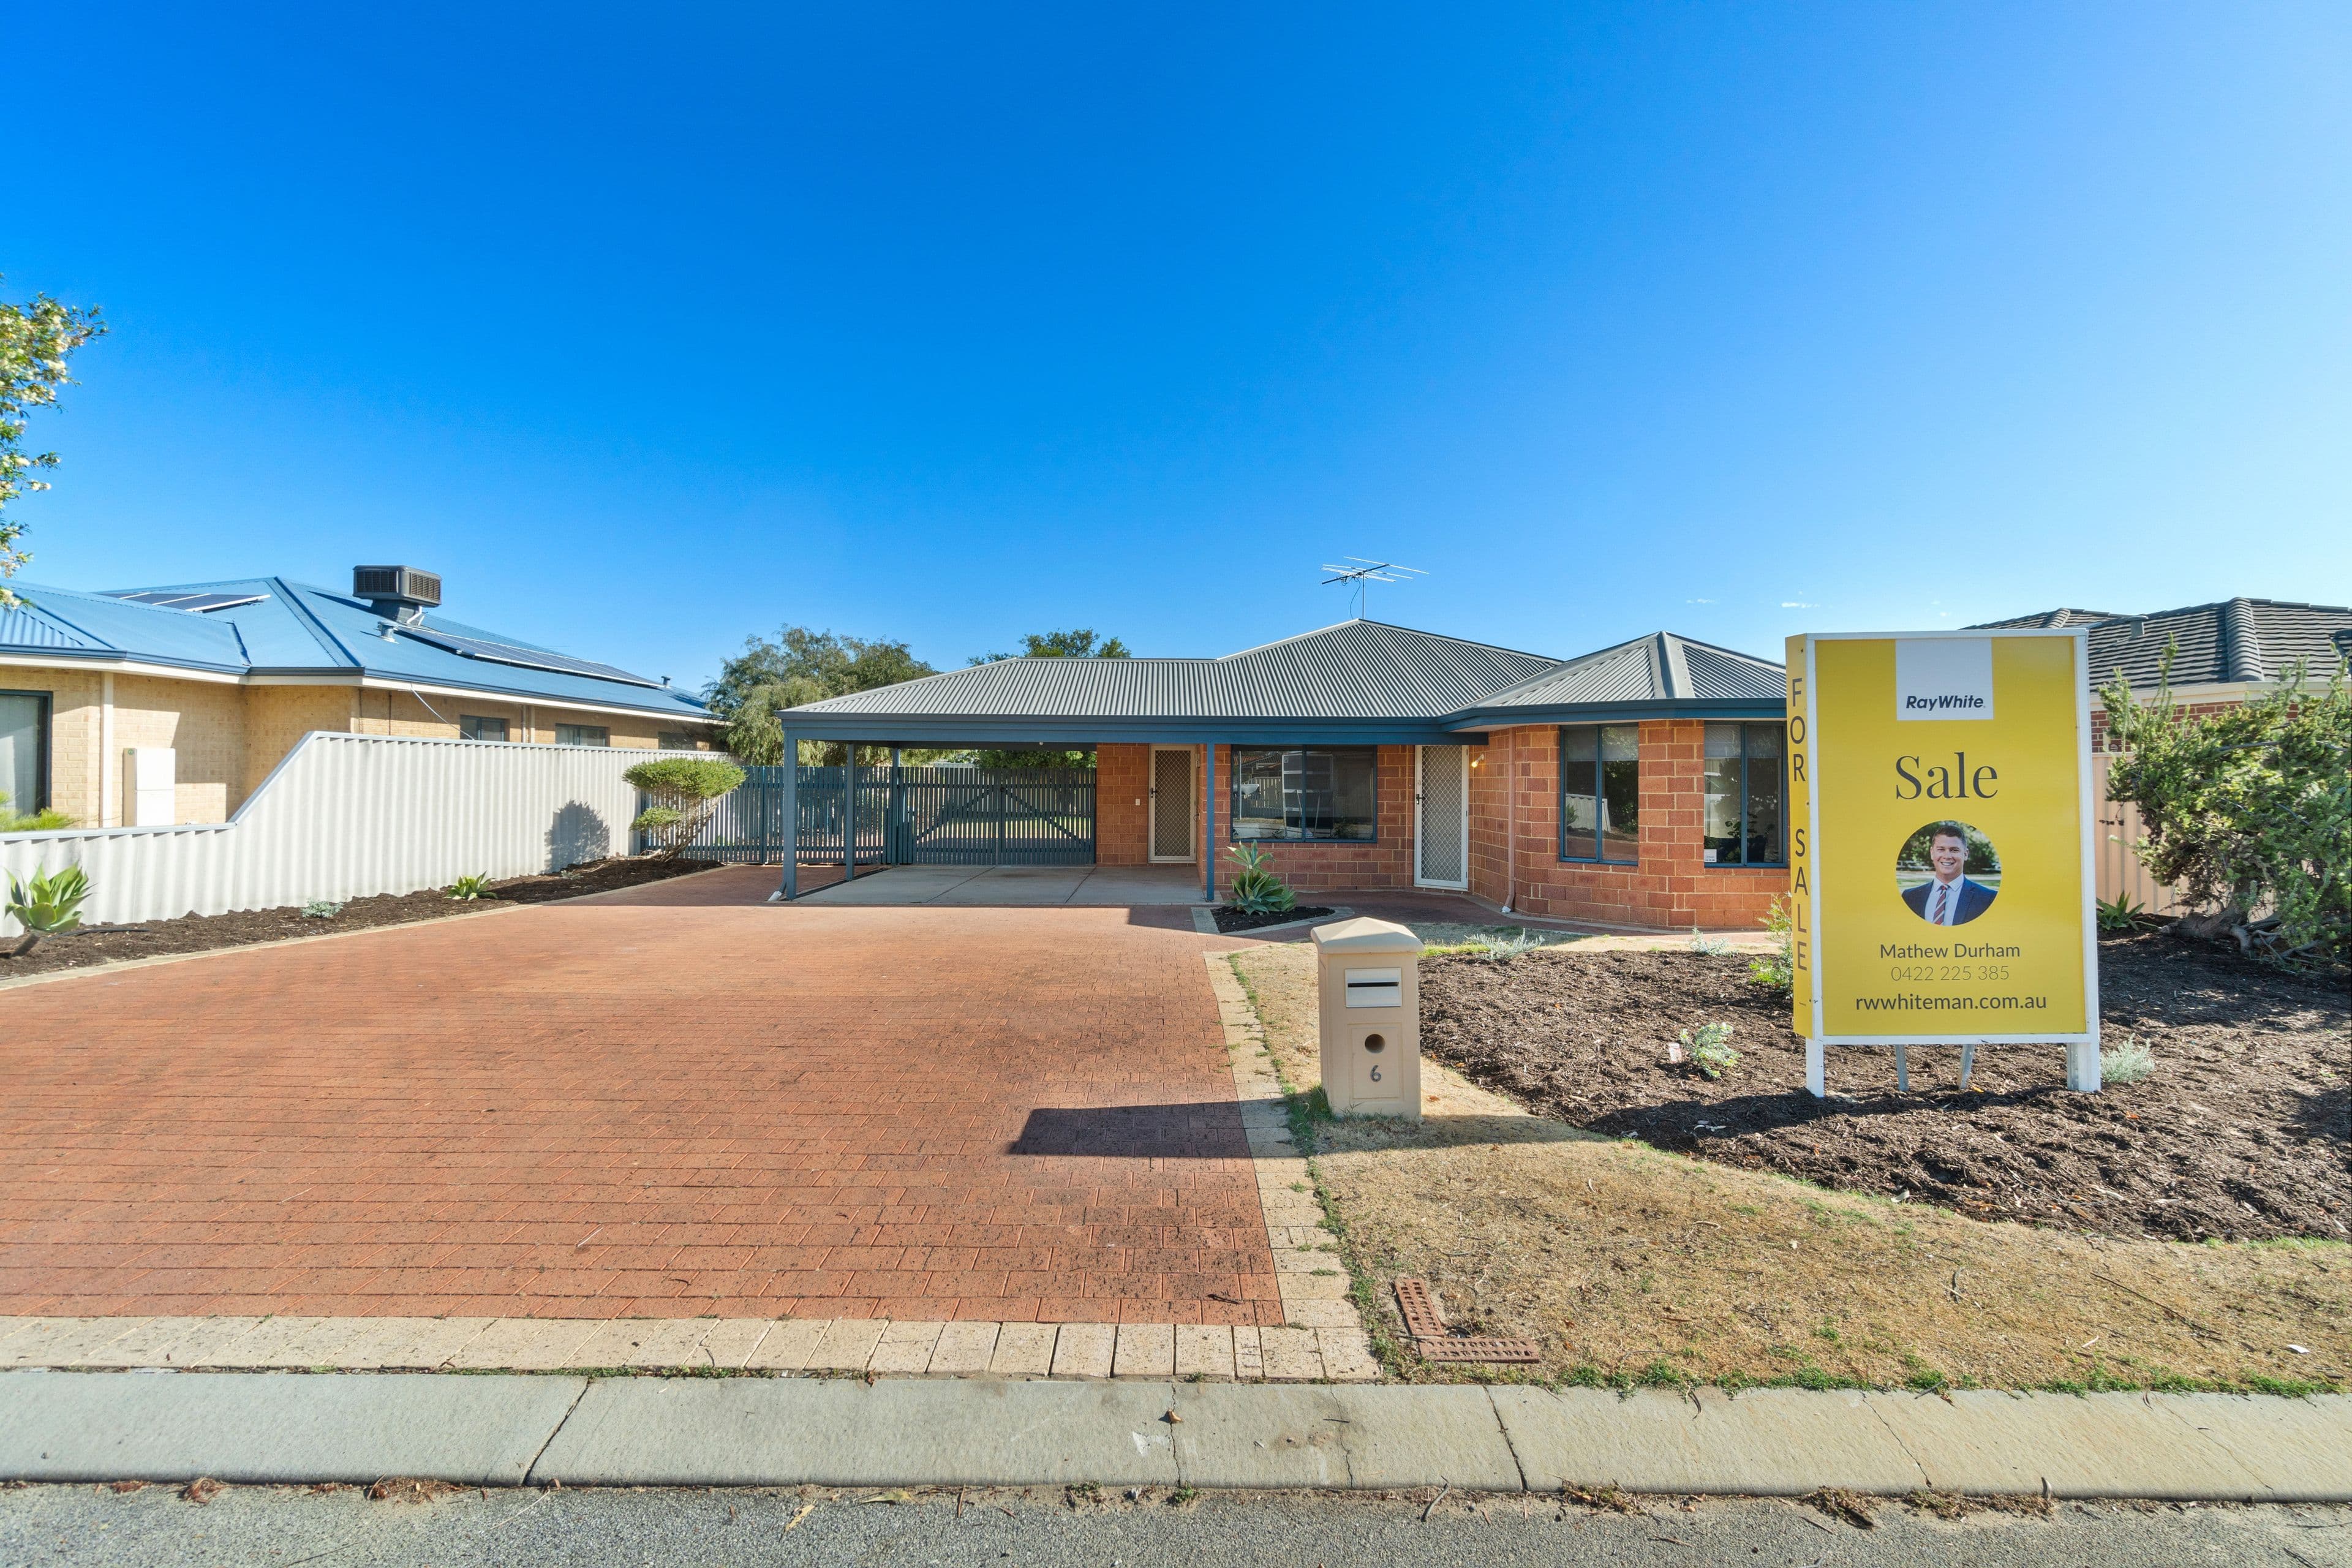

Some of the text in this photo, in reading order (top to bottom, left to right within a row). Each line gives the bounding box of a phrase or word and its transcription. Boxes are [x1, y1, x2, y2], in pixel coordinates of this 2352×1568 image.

[1896, 752, 1998, 800] Sale
[1790, 678, 1808, 971] FOR SALE
[1880, 943, 2020, 959] Mathew Durham
[1891, 965, 2010, 981] 0422 225 385
[1856, 993, 2046, 1010] rwwhiteman.com.au
[1370, 1065, 1382, 1082] 6
